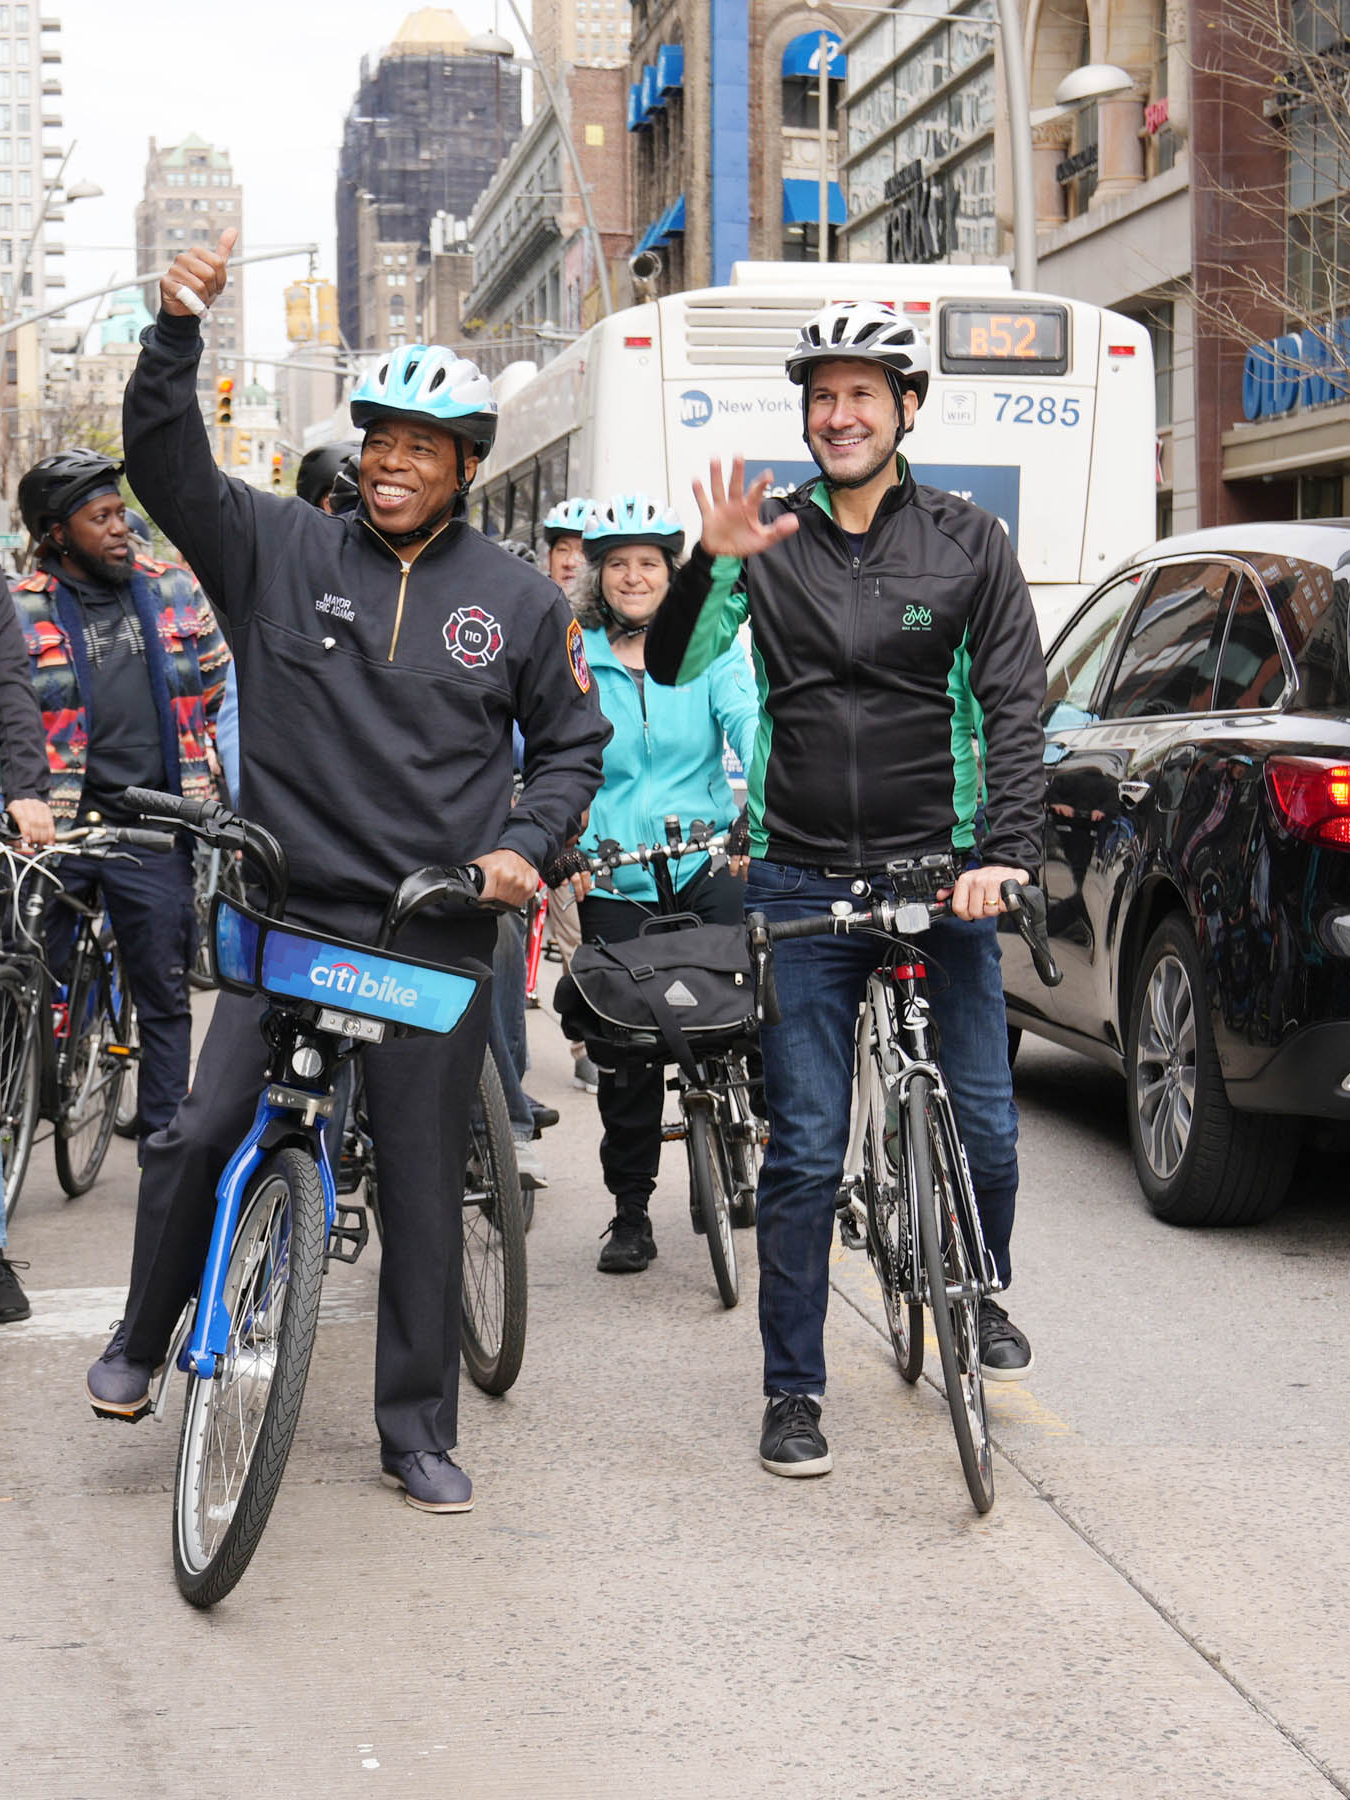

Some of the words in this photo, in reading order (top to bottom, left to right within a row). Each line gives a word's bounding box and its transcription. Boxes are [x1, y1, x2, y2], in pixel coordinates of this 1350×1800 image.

[970, 316, 1037, 358] B52
[718, 399, 753, 413] New
[757, 398, 793, 412] York
[993, 392, 1081, 426] 7285
[315, 600, 331, 613] ERIC
[330, 605, 356, 622] ADAMS
[324, 592, 352, 610] MAYOR
[465, 630, 482, 643] 110
[310, 963, 361, 993] citi
[357, 971, 419, 1008] bike
